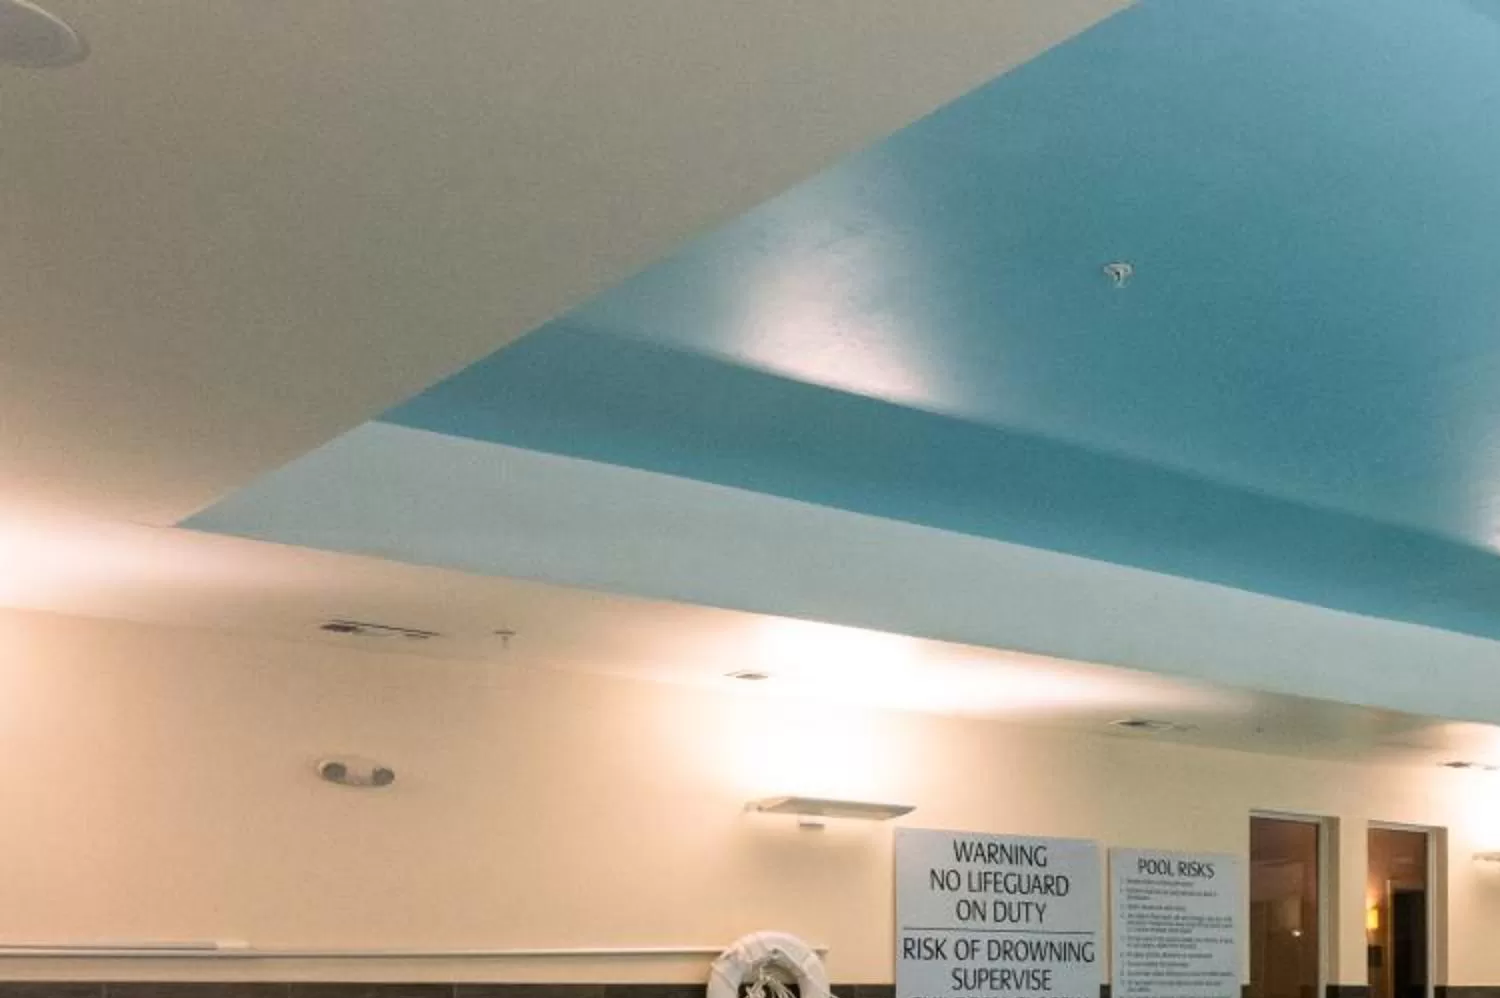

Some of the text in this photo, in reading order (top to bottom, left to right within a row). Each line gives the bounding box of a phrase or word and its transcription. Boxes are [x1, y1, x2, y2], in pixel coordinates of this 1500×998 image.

[953, 840, 1047, 867] WARNING
[1138, 858, 1215, 880] POOL RISKS
[930, 868, 1069, 896] NO LIFEGUARD
[956, 899, 1047, 923] ON DUTY
[903, 937, 1095, 962] RISK OF DROWNING
[951, 967, 1053, 991] SUPERVISE
